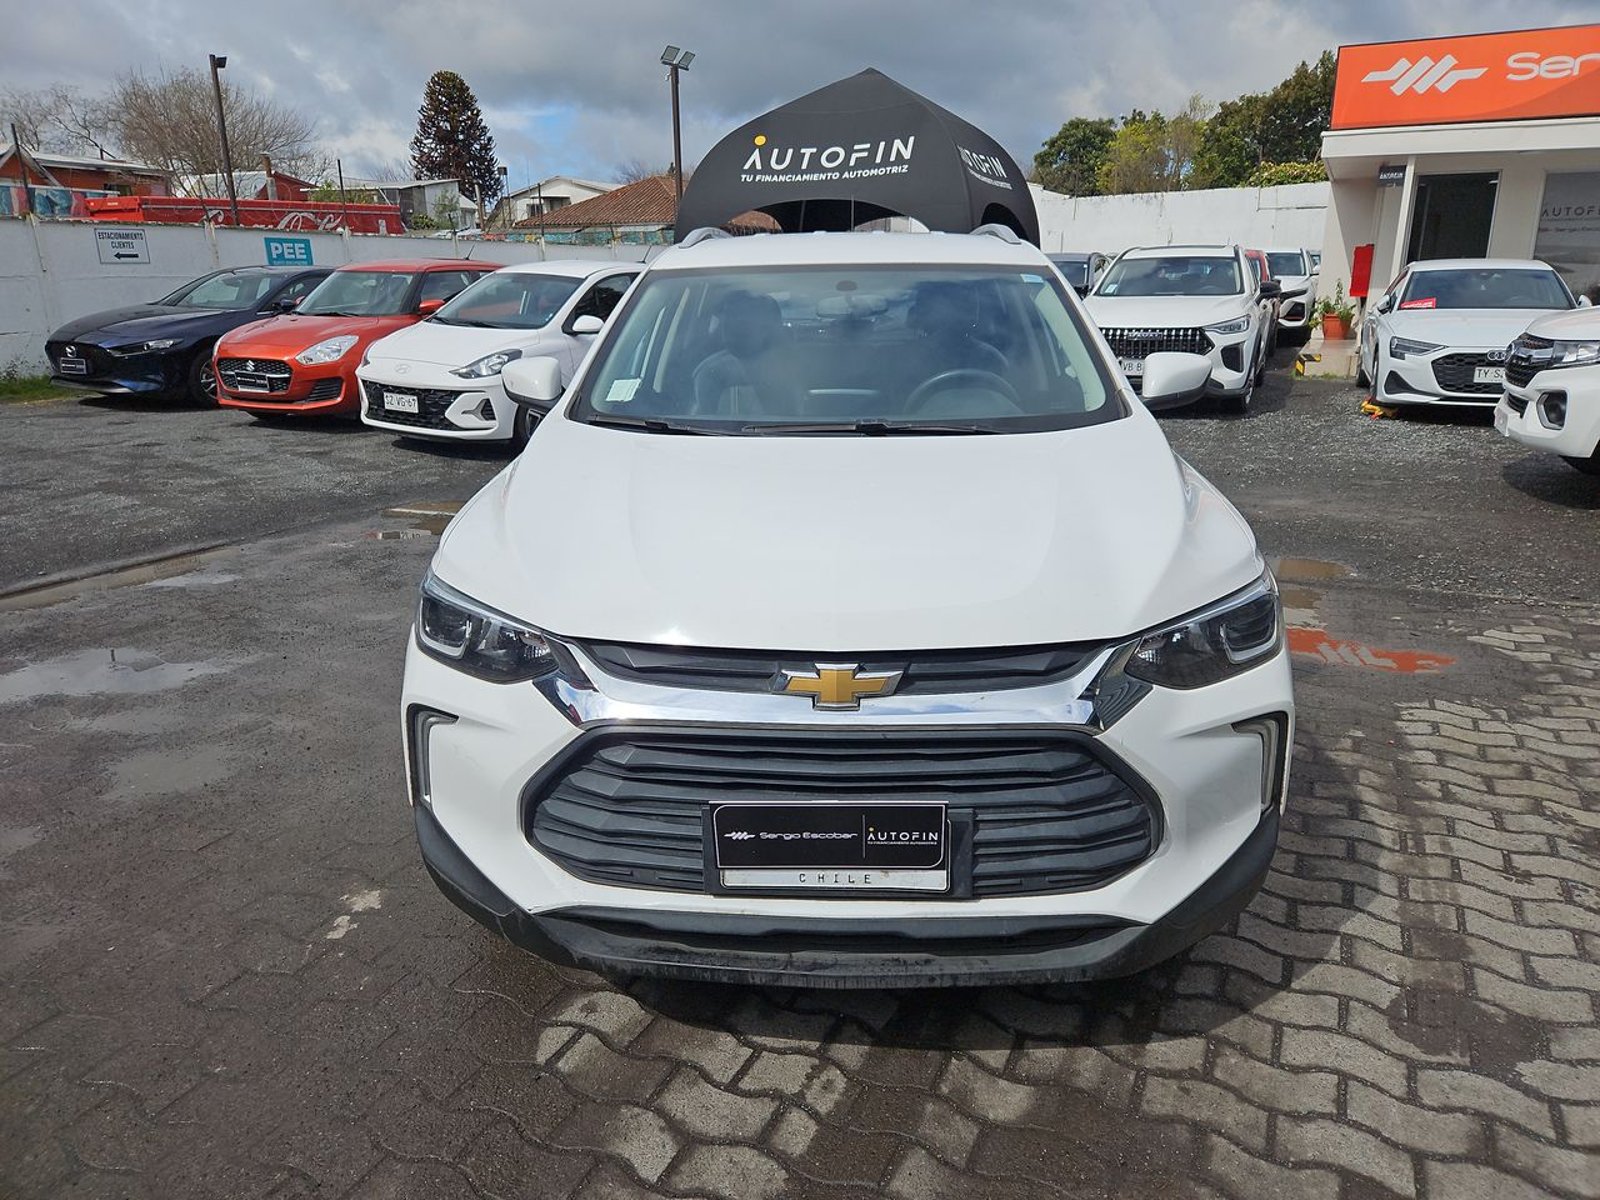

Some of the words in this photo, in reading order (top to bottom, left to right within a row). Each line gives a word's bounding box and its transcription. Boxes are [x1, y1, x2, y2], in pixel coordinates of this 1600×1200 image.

[743, 135, 915, 170] AUTOFIN
[740, 174, 753, 182] TU
[755, 172, 839, 182] FINANCIAMIENTO
[842, 165, 909, 179] AUTOMOTRIZ
[98, 232, 145, 242] ESTACIONAMIENTO
[110, 241, 135, 250] CLIENTES
[270, 242, 307, 260] PEE
[867, 828, 938, 841] AUTOFIN
[799, 873, 872, 884] CHILE
